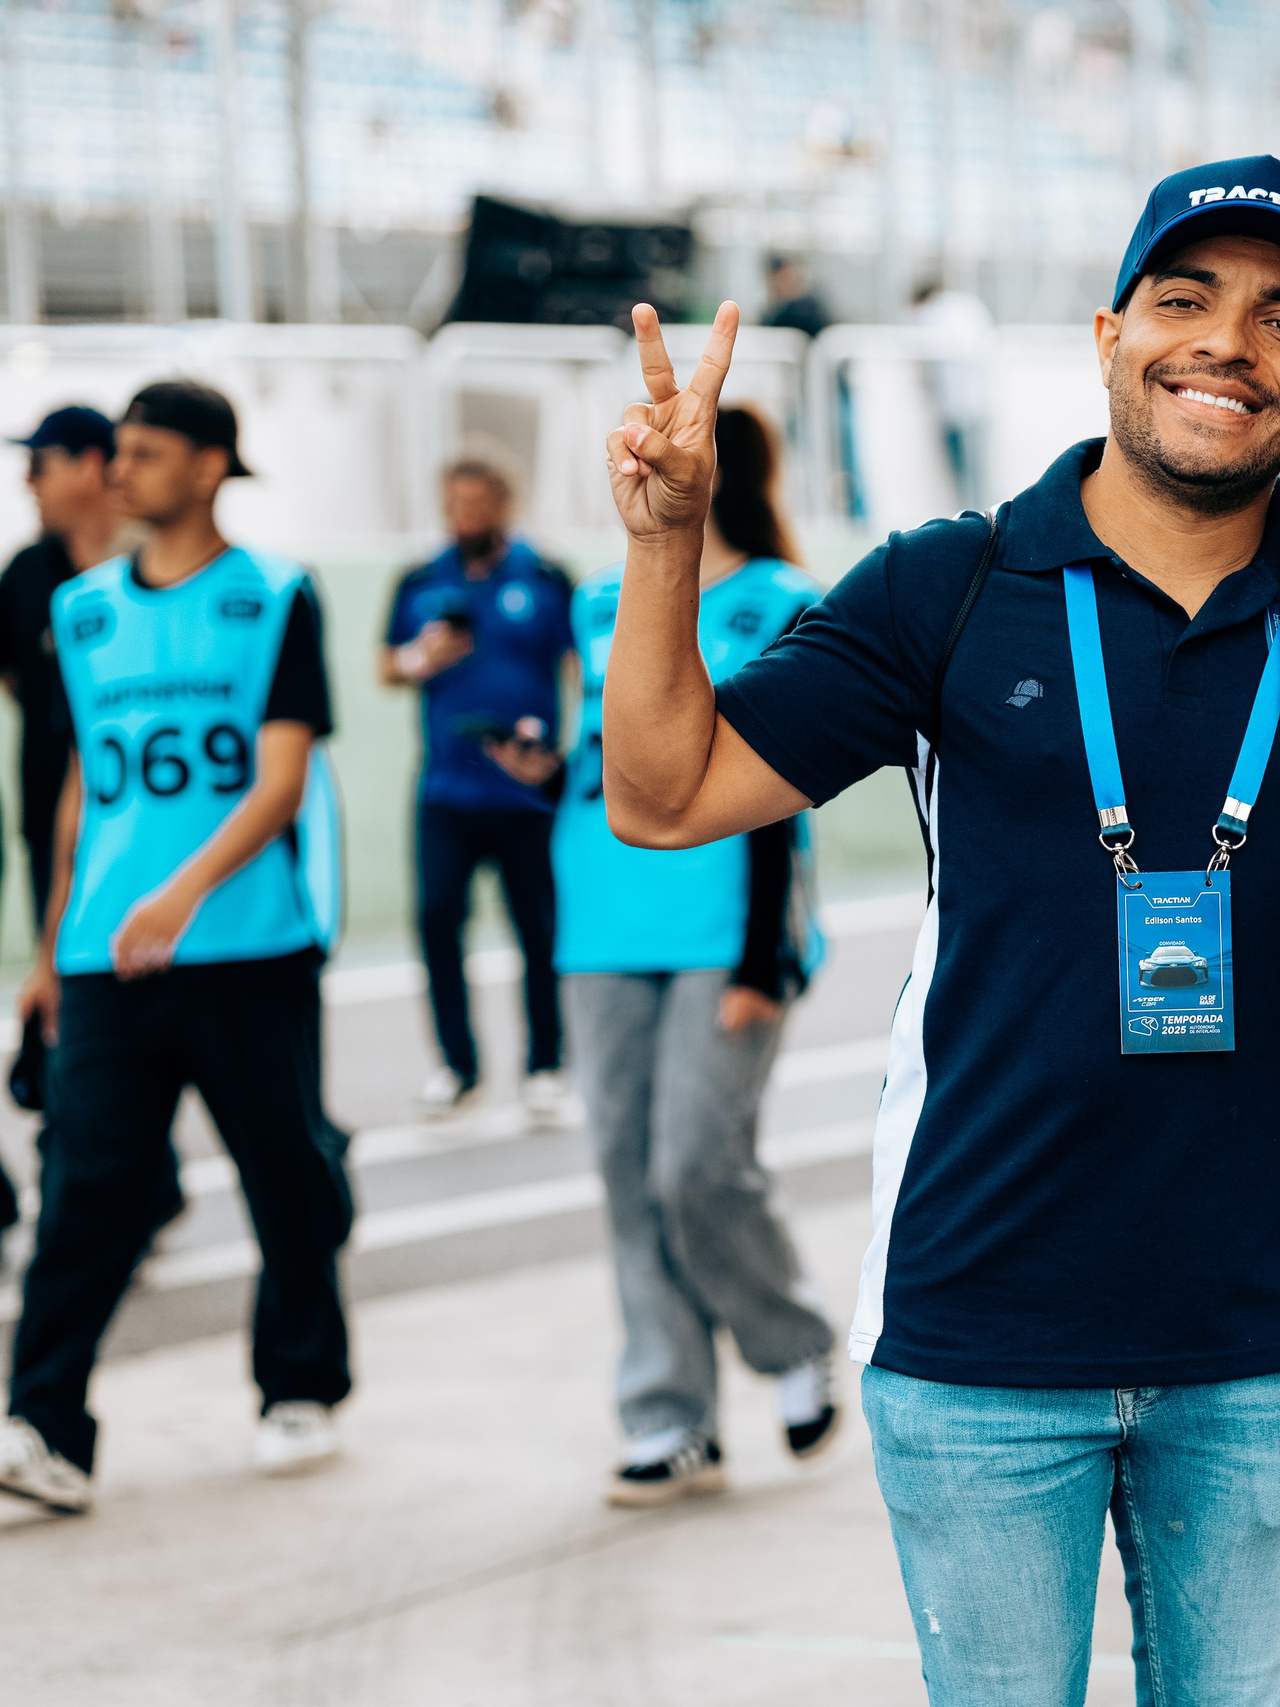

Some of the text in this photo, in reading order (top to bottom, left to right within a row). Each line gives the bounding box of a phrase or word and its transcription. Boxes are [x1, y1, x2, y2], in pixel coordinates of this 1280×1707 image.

[1152, 896, 1191, 904] TRACTIAN
[1144, 915, 1202, 925] Edilson Santos
[1161, 1014, 1223, 1025] TEMPORADA
[1161, 1025, 1187, 1035] 2025
